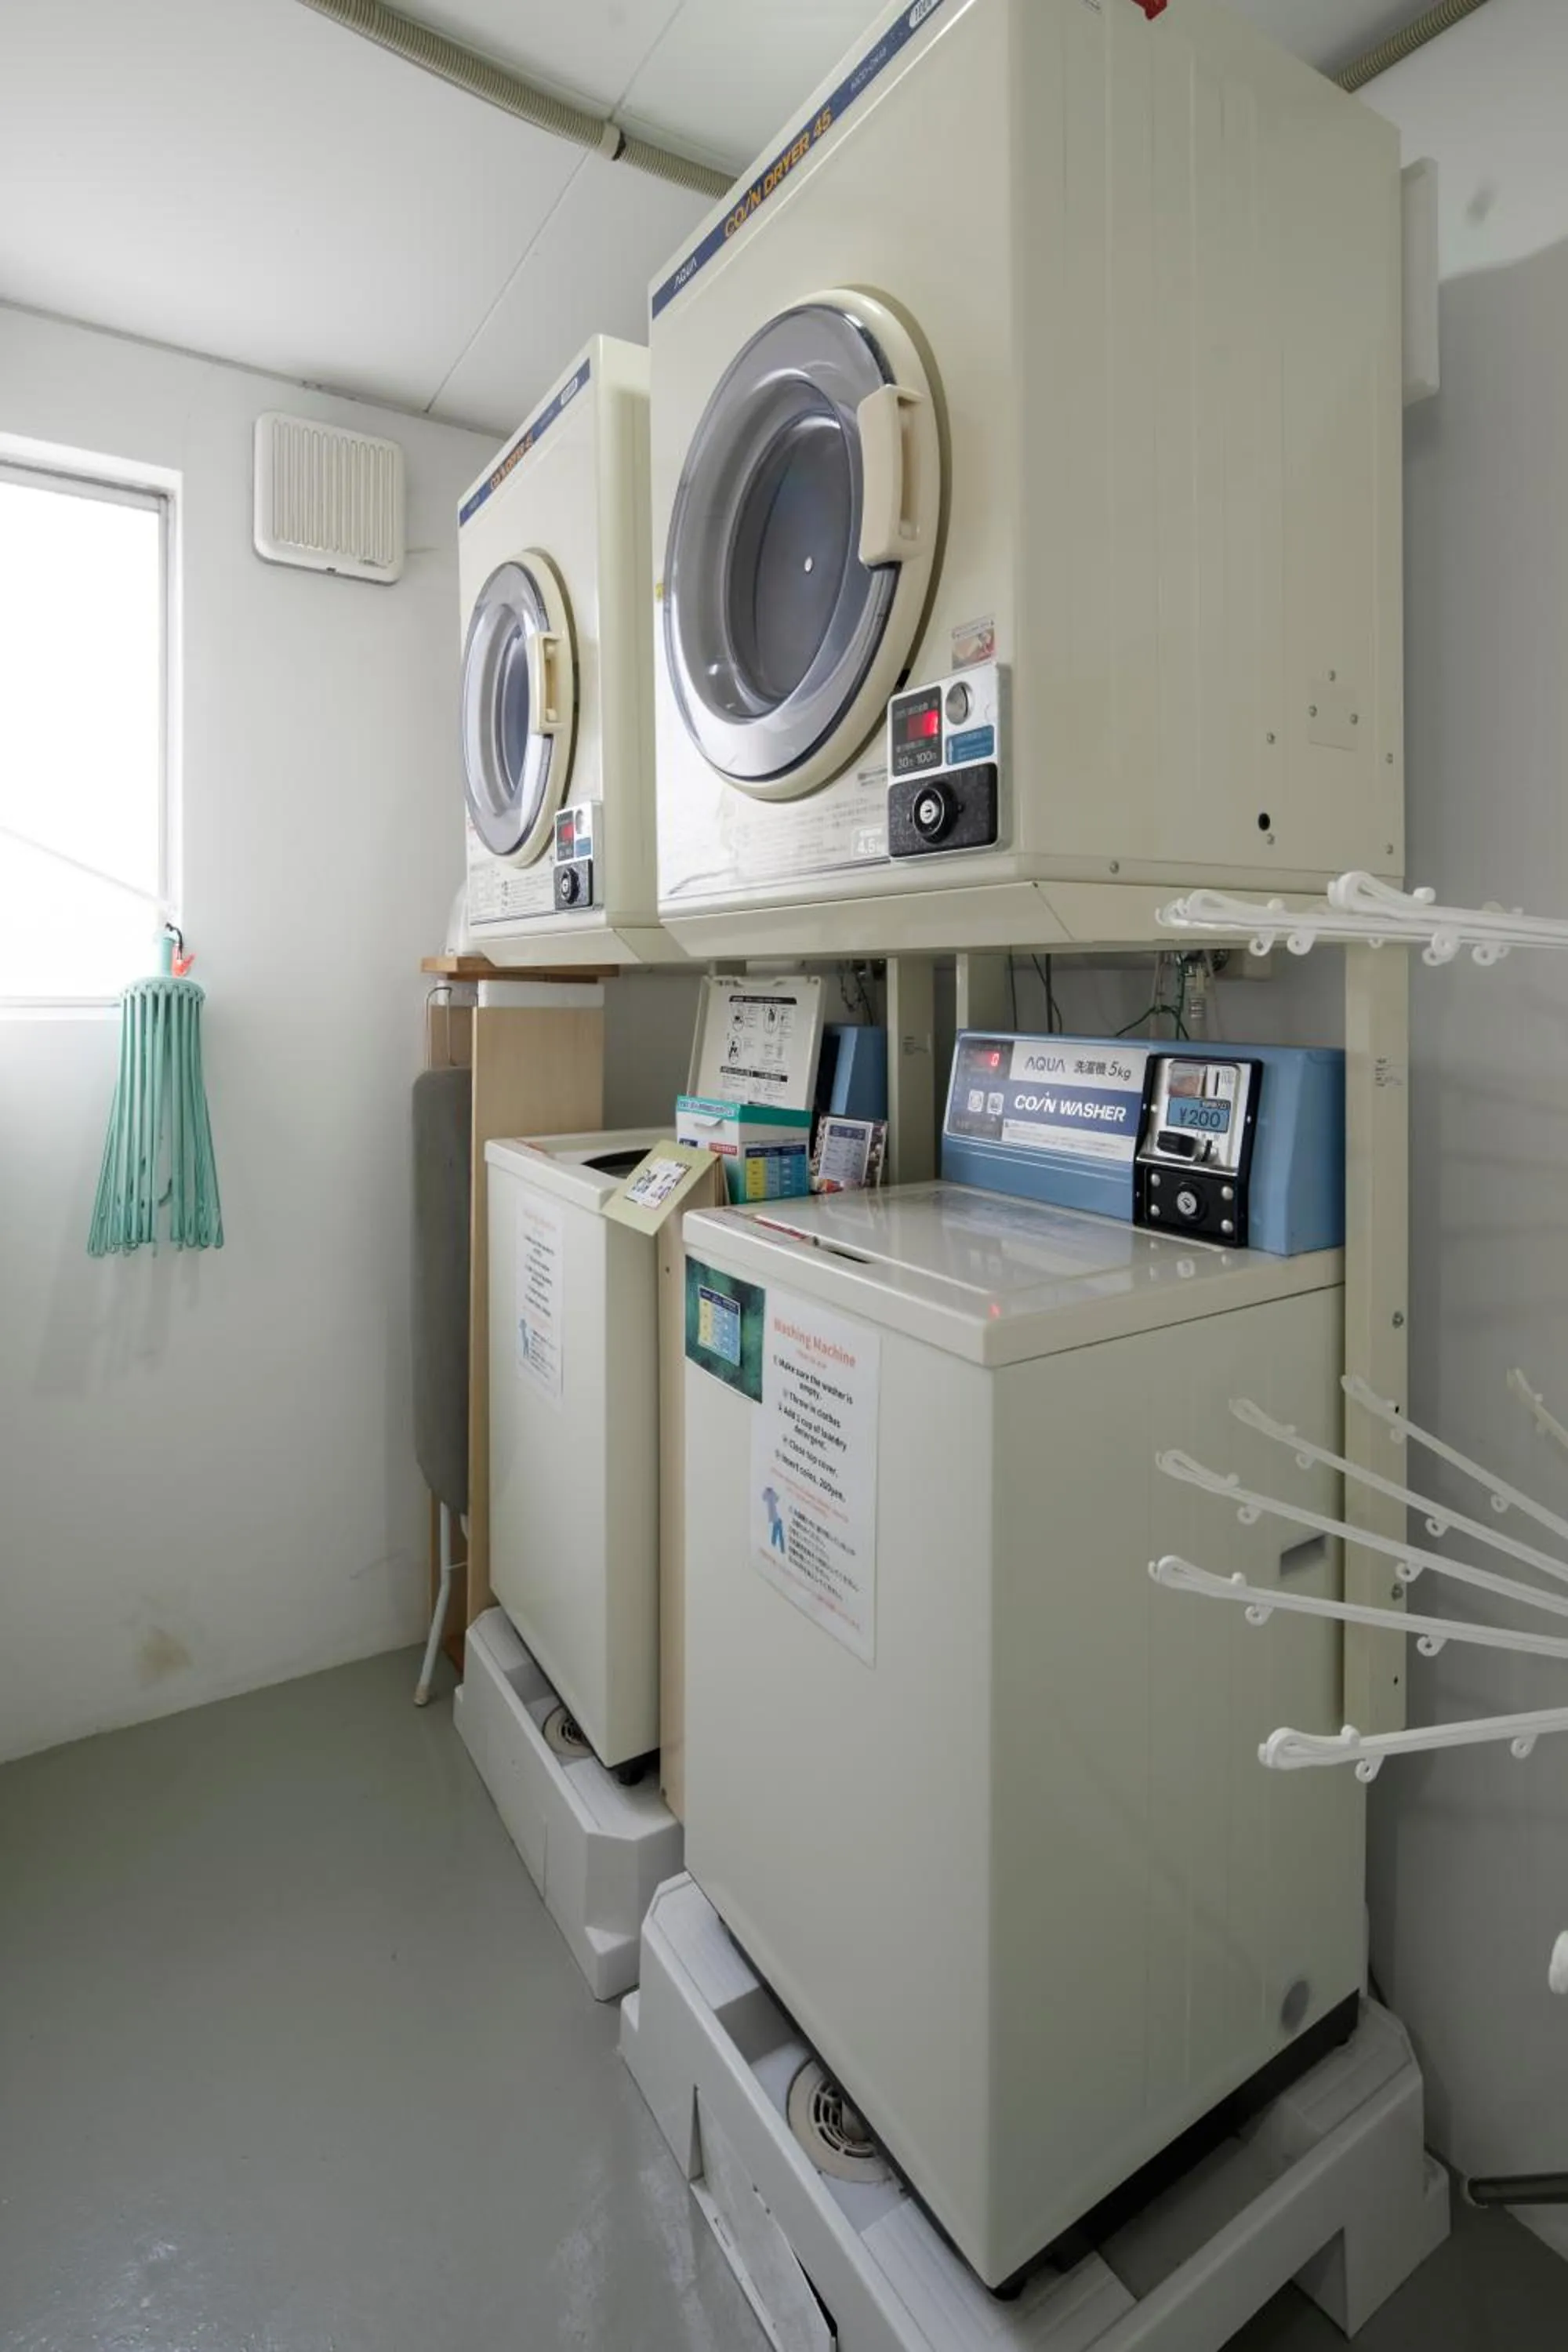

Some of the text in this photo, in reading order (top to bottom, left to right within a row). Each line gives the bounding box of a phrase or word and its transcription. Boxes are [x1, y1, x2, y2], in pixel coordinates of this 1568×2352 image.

[763, 132, 811, 196] DRYER
[814, 107, 833, 138] 45
[1024, 1055, 1065, 1073] AQUA
[1108, 1061, 1131, 1081] 5kg
[1060, 1099, 1127, 1123] WASHER
[1179, 1106, 1221, 1127] ¥200
[773, 1317, 811, 1350] Washing
[813, 1335, 856, 1368] Machine
[779, 1358, 796, 1374] Make
[810, 1374, 821, 1387] the
[784, 1406, 796, 1420] Add
[790, 1392, 809, 1410] Throw
[782, 1454, 799, 1472] Insert
